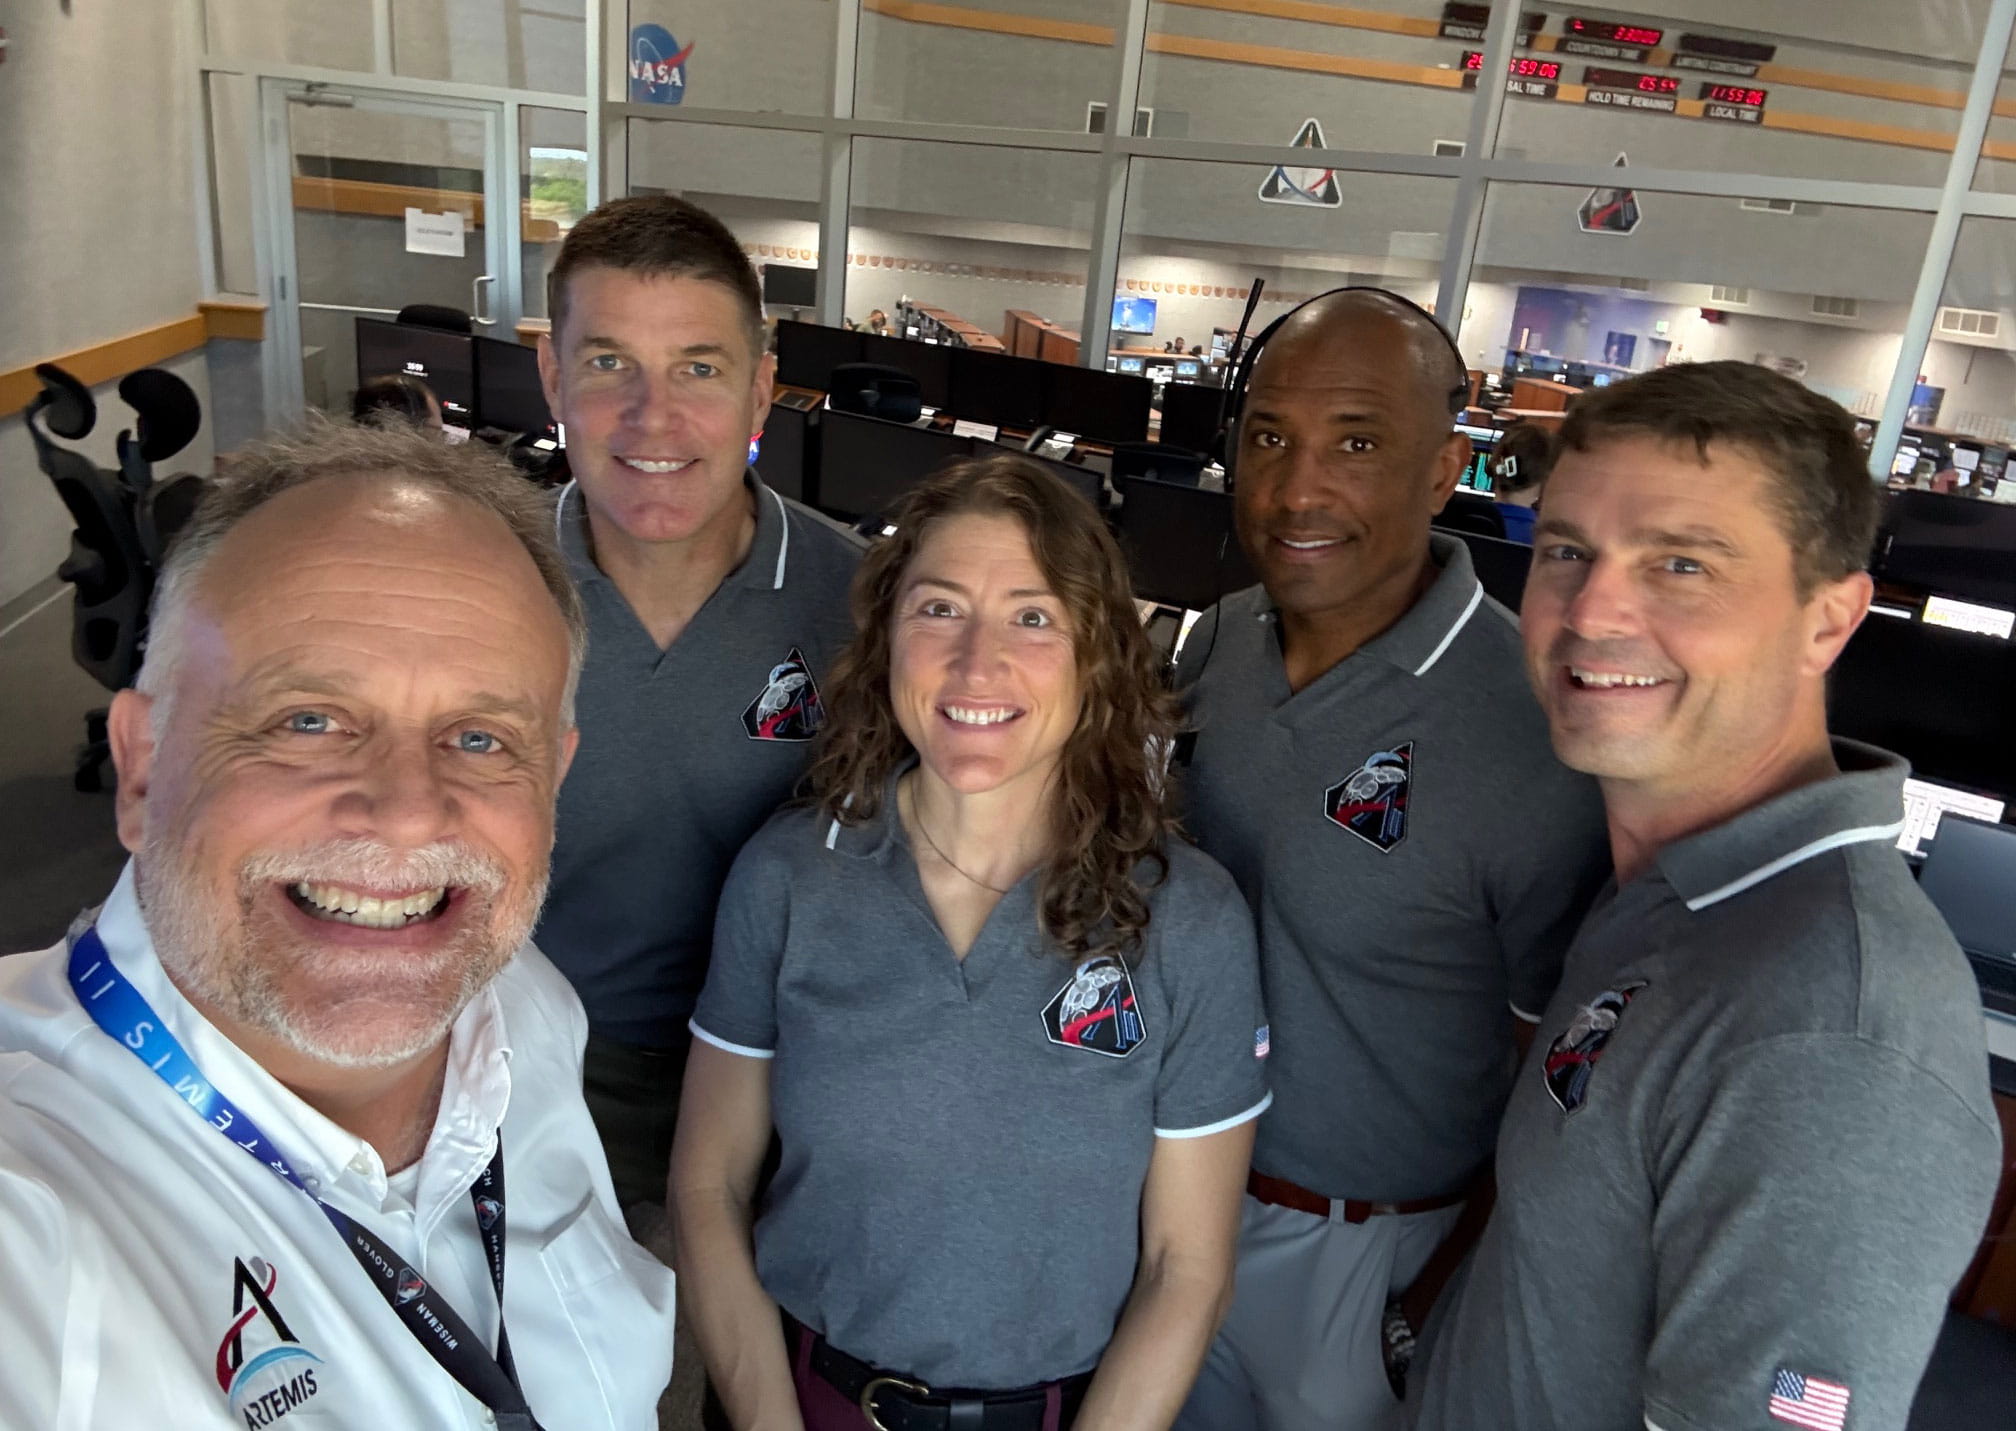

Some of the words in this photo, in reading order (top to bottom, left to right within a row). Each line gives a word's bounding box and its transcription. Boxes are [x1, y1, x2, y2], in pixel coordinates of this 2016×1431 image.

[629, 59, 683, 87] NASA
[1525, 83, 1547, 96] TIME
[1588, 91, 1611, 104] HOLD
[1612, 94, 1631, 106] TIME
[1631, 96, 1675, 112] REMAINING
[1710, 106, 1736, 119] LOCAL
[1739, 110, 1758, 122] TIME
[124, 1021, 290, 1176] RTEMIS
[482, 1168, 493, 1187] CH
[356, 1234, 395, 1280] GLOVER
[416, 1302, 459, 1351] WISEMAN
[243, 1368, 318, 1431] ARTEMIS
